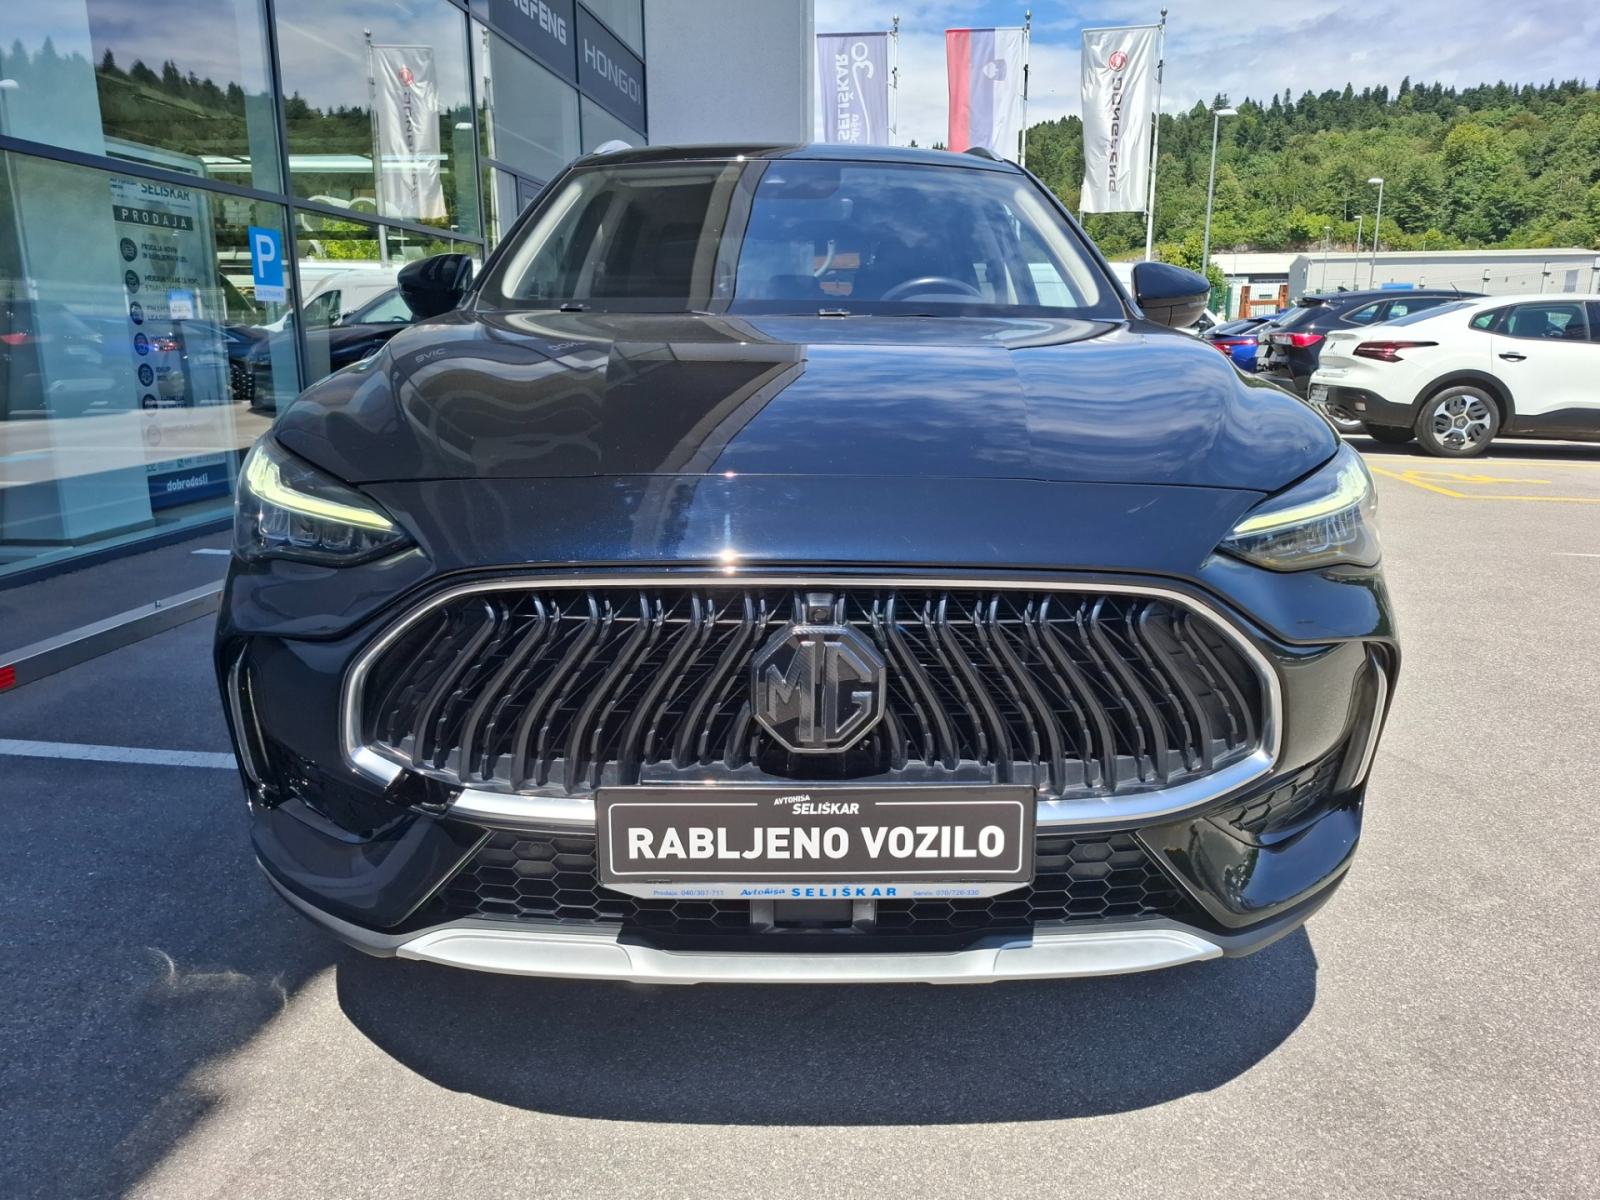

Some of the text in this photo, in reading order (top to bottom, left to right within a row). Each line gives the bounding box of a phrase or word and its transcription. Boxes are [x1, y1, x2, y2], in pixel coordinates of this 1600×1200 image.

[121, 208, 187, 229] PRODAJA
[255, 234, 276, 279] P
[766, 640, 873, 742] MG
[791, 801, 860, 815] SELIŠKAR
[627, 825, 1006, 860] RABLJENO VOZILO
[791, 886, 897, 897] SELIŠKAR
